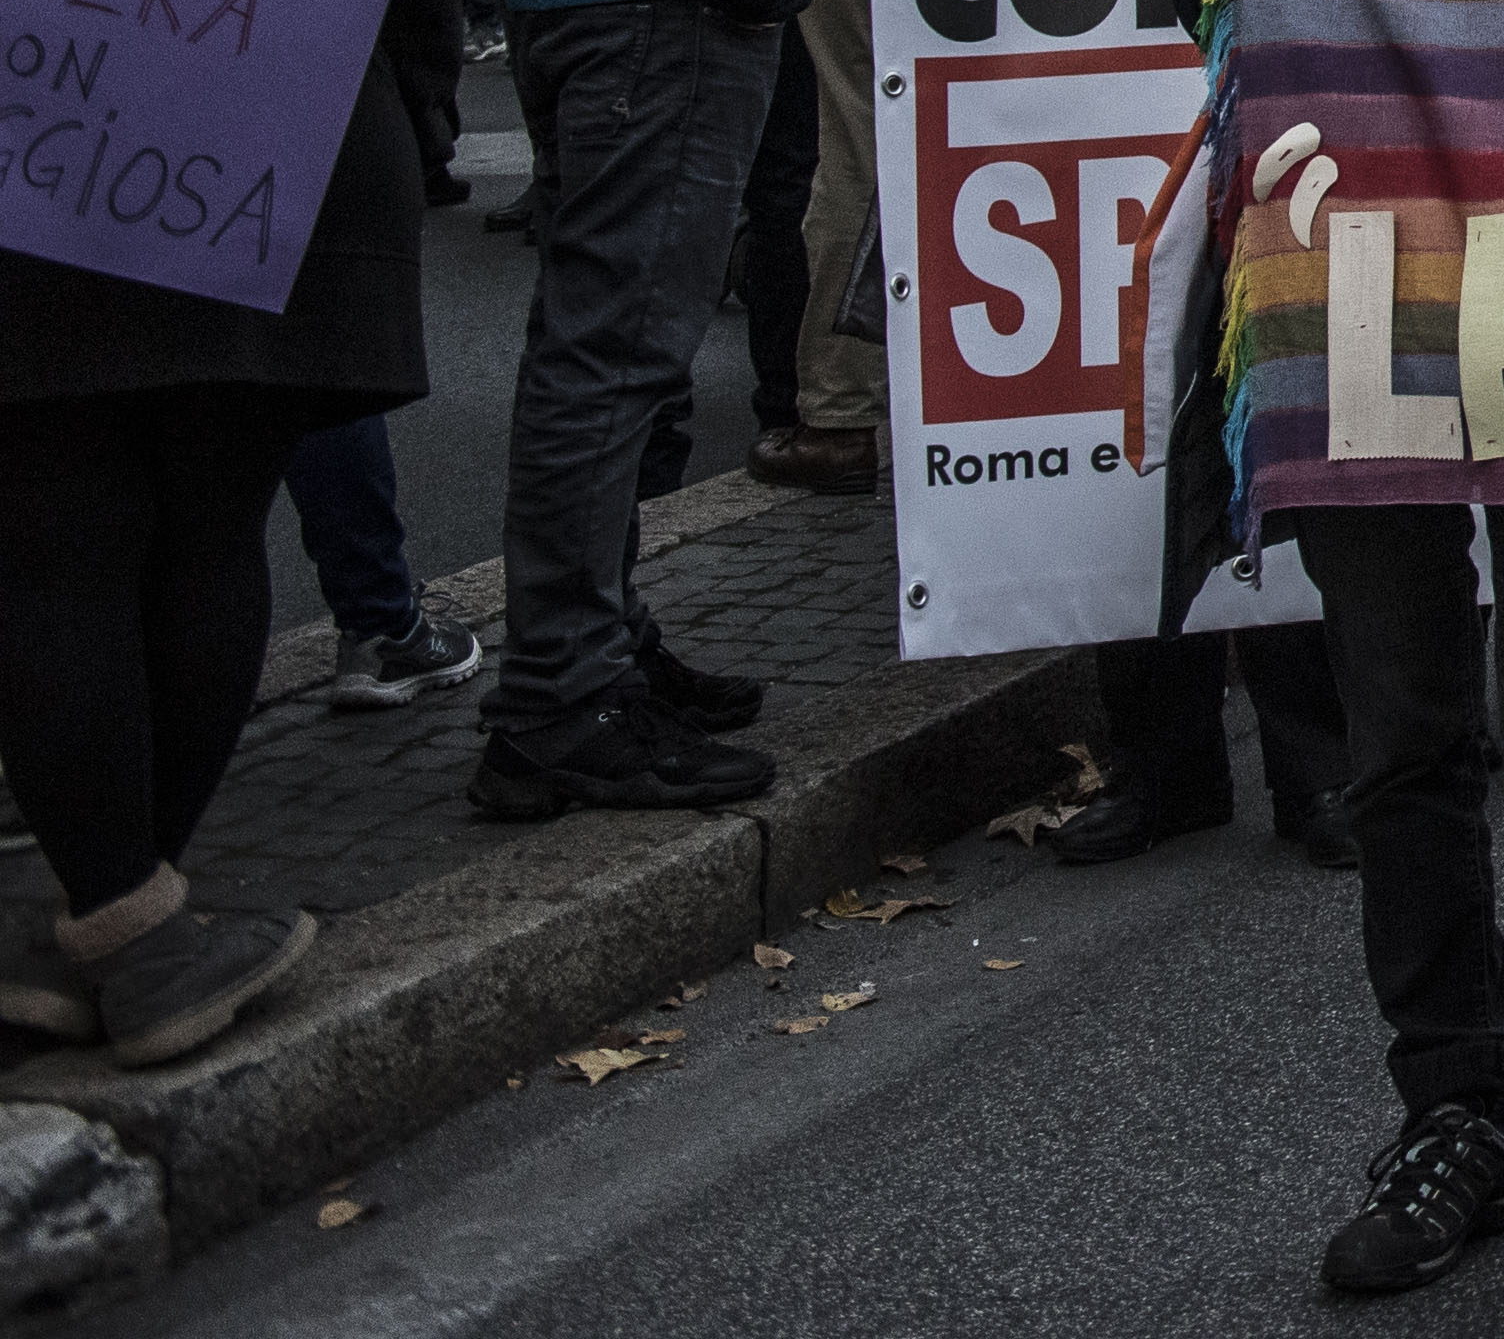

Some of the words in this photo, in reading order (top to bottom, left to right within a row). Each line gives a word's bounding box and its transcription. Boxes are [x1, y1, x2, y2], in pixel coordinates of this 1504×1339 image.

[949, 153, 1172, 379] SP
[926, 442, 1070, 488] Roma
[1090, 445, 1122, 475] e
